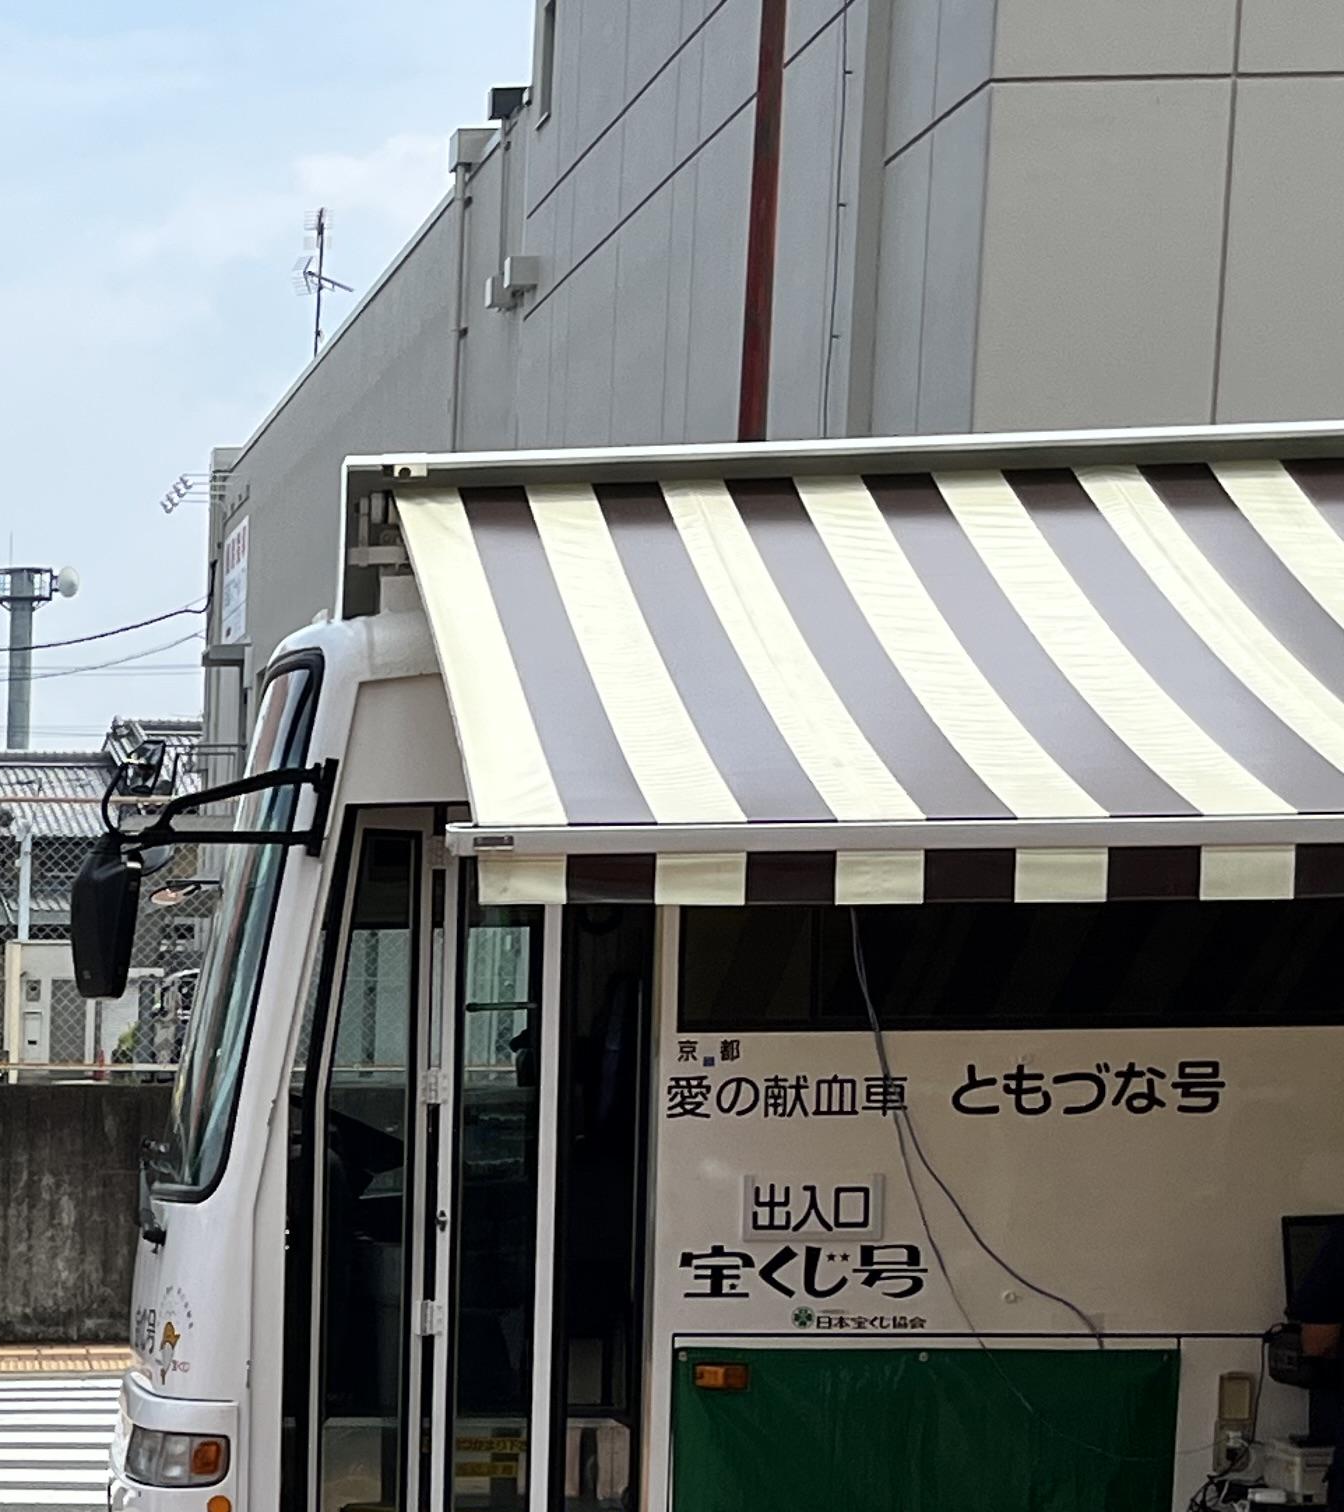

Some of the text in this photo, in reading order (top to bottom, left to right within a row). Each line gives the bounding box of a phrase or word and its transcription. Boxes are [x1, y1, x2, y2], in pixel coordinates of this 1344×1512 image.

[666, 1060, 1226, 1118] 愛の献血車 ともづな号
[752, 1183, 870, 1232] 出入口
[679, 1245, 928, 1298] 宝くじ号
